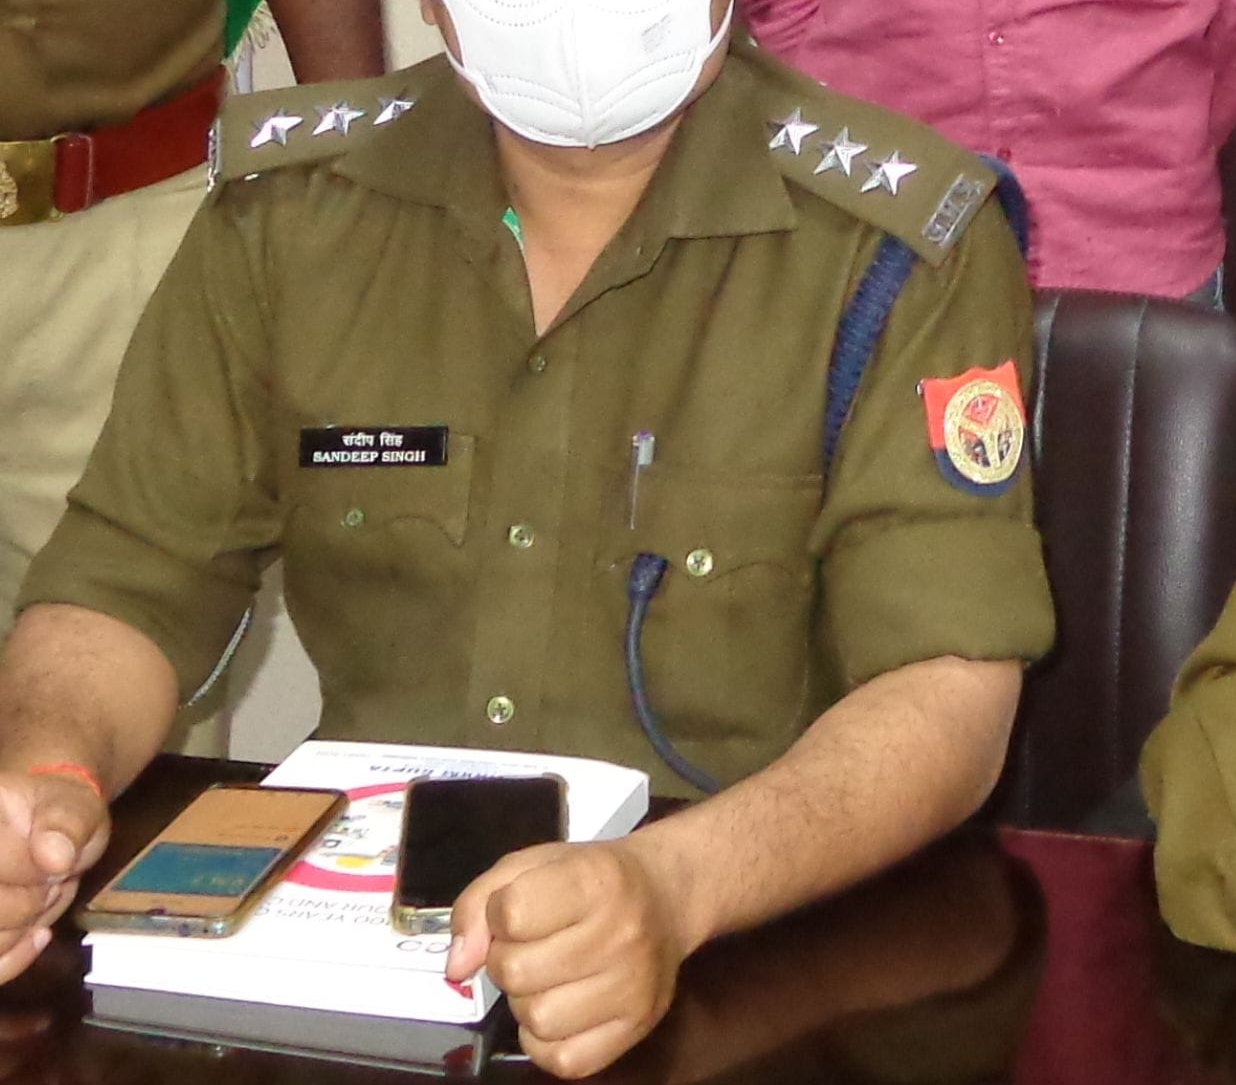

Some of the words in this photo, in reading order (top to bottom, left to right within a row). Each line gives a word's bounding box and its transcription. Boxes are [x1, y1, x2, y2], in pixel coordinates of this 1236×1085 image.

[342, 432, 375, 447] संदीप
[380, 432, 404, 447] सिंह
[312, 451, 379, 463] SANDEEP
[381, 450, 426, 462] SINGH
